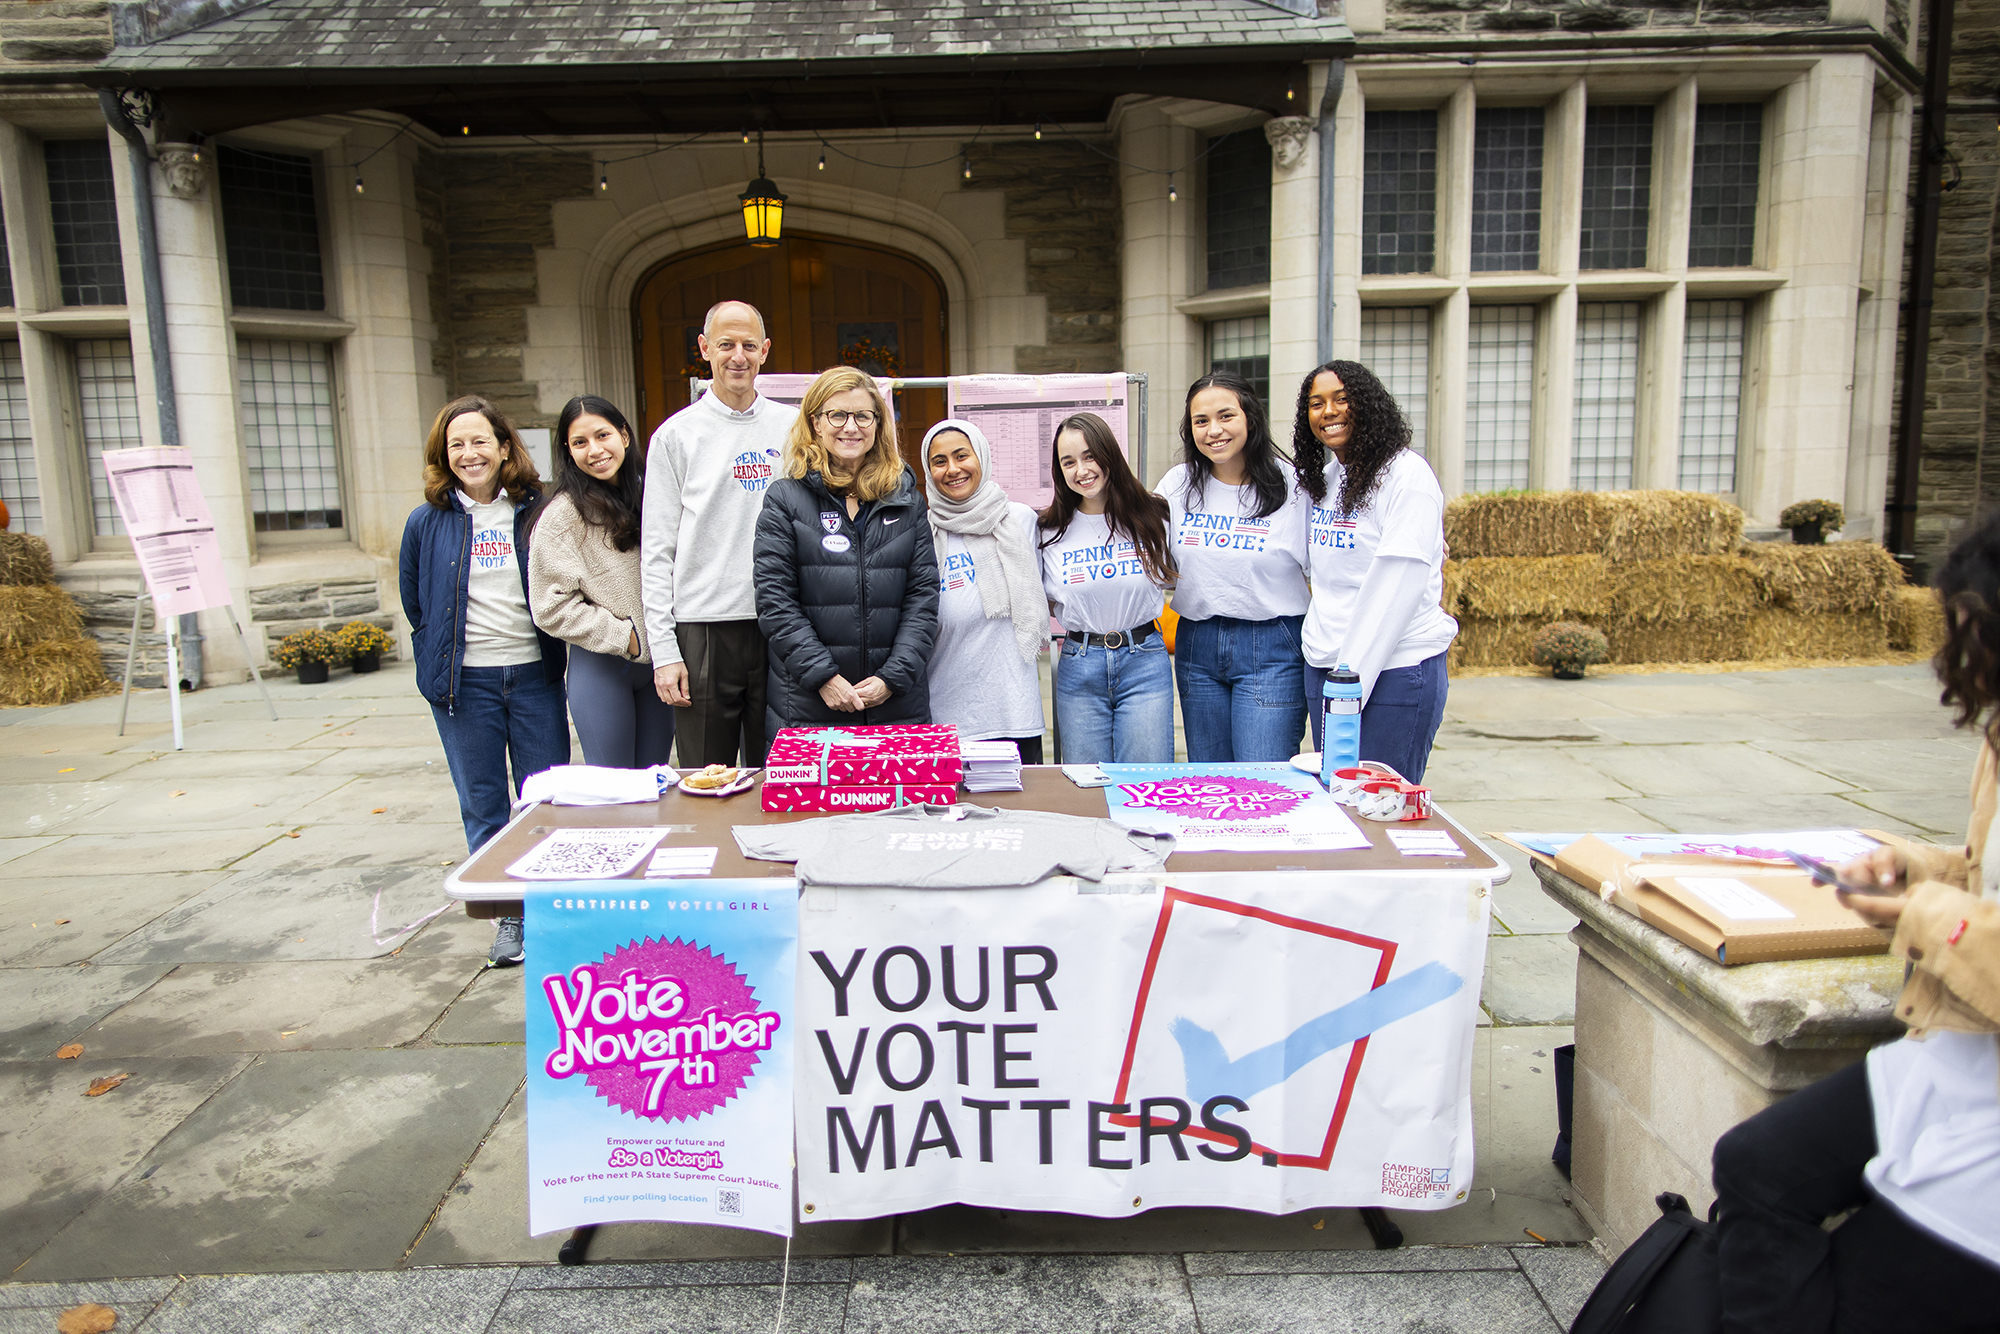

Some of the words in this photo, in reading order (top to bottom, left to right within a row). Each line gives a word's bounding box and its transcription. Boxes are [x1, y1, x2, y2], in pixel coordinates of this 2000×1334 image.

[735, 451, 766, 465] PENN
[733, 464, 758, 479] LEADS
[758, 464, 772, 478] THE
[740, 477, 768, 491] VOTE
[1181, 512, 1235, 531] PENN
[1238, 517, 1271, 528] LEADS
[1311, 506, 1333, 525] ENN
[473, 529, 507, 544] PENN
[1203, 531, 1257, 550] VOTE
[1314, 528, 1346, 549] VOTE
[498, 542, 512, 556] THE
[1062, 544, 1114, 566] PENN
[477, 555, 507, 568] VOTE
[1070, 566, 1083, 574] THE
[1086, 559, 1143, 580] VOTE
[770, 769, 813, 779] DUNKIN'
[1122, 782, 1231, 797] Vote
[830, 792, 891, 805] DUNKIN'
[1127, 791, 1311, 808] November
[1201, 801, 1267, 818] 7th
[888, 832, 970, 843] PENN
[553, 899, 650, 911] CERTIFIED
[667, 900, 770, 911] VOTERGIRL
[808, 943, 1059, 1017] YOUR
[548, 970, 685, 1030] Vote
[551, 1012, 776, 1074] November
[813, 1020, 1040, 1096] VOTE
[640, 1053, 715, 1111] 7th
[825, 1094, 1279, 1174] MATTERS.
[606, 1137, 653, 1147] Empower
[655, 1138, 673, 1146] our
[675, 1137, 705, 1147] future
[707, 1138, 725, 1147] and
[610, 1148, 637, 1167] Be
[641, 1152, 652, 1166] a
[656, 1149, 723, 1170] Votergirl.
[1382, 1162, 1431, 1176] CAMPUS
[543, 1177, 567, 1188] Vote
[570, 1175, 585, 1183] for
[587, 1172, 604, 1181] the
[606, 1171, 629, 1179] next
[631, 1171, 644, 1179] PA
[646, 1171, 671, 1179] State
[673, 1171, 716, 1182] Supreme
[718, 1173, 745, 1185] Court
[747, 1176, 782, 1191] Justice.
[1382, 1170, 1431, 1184] ELECTION
[1381, 1178, 1452, 1192] ENGAGEMENT
[1381, 1186, 1429, 1199] PROJECT
[583, 1194, 605, 1204] Find
[607, 1194, 629, 1204] your
[632, 1192, 667, 1204] polling
[668, 1193, 708, 1203] location
